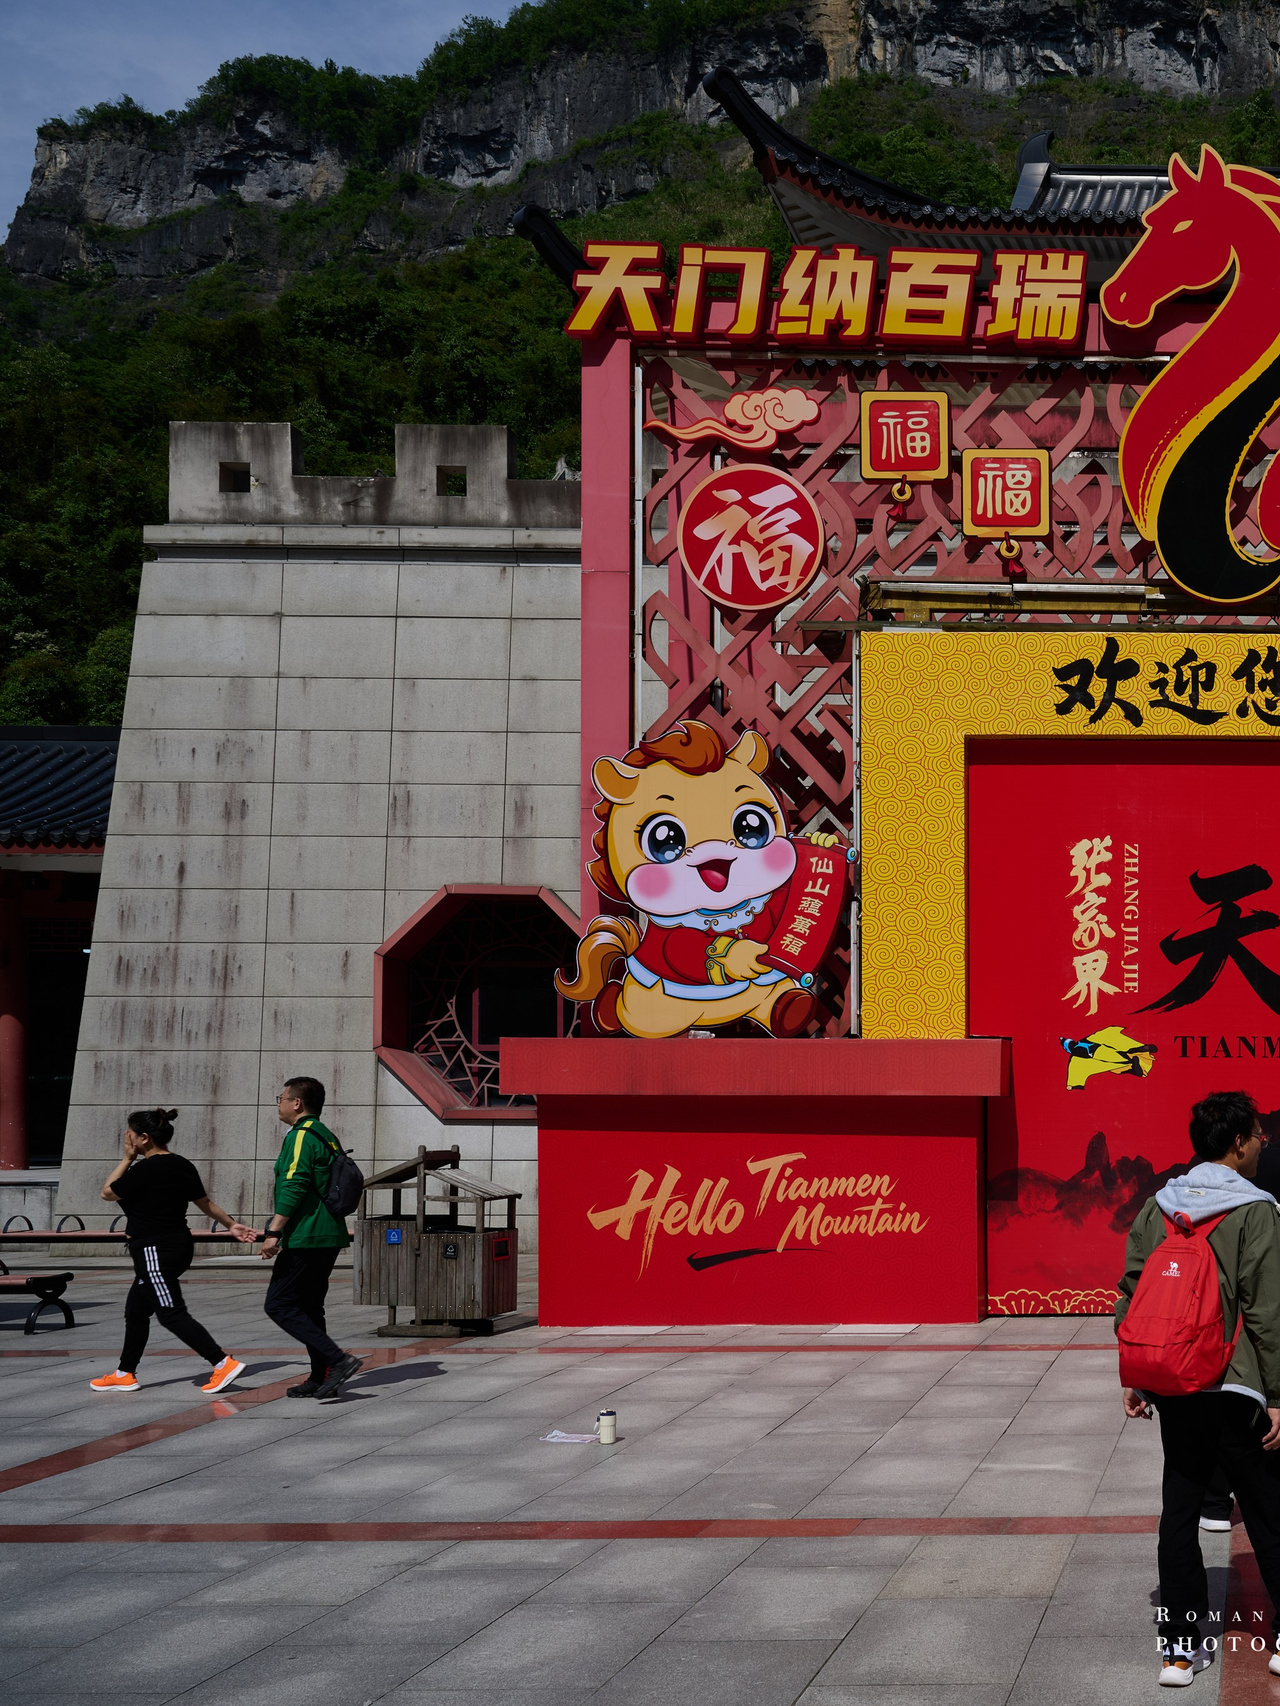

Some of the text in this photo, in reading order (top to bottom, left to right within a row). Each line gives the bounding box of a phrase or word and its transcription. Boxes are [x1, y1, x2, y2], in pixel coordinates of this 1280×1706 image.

[566, 242, 1088, 343] 天门纳百瑞
[878, 410, 932, 465] 福
[692, 483, 815, 595] 福
[976, 463, 1032, 519] 福
[1061, 835, 1123, 1017] 张家界
[1120, 843, 1139, 994] ZHANG JIA JIE
[586, 1163, 746, 1284] Hello
[746, 1152, 900, 1220] Tianmen
[776, 1197, 932, 1254] Mountain
